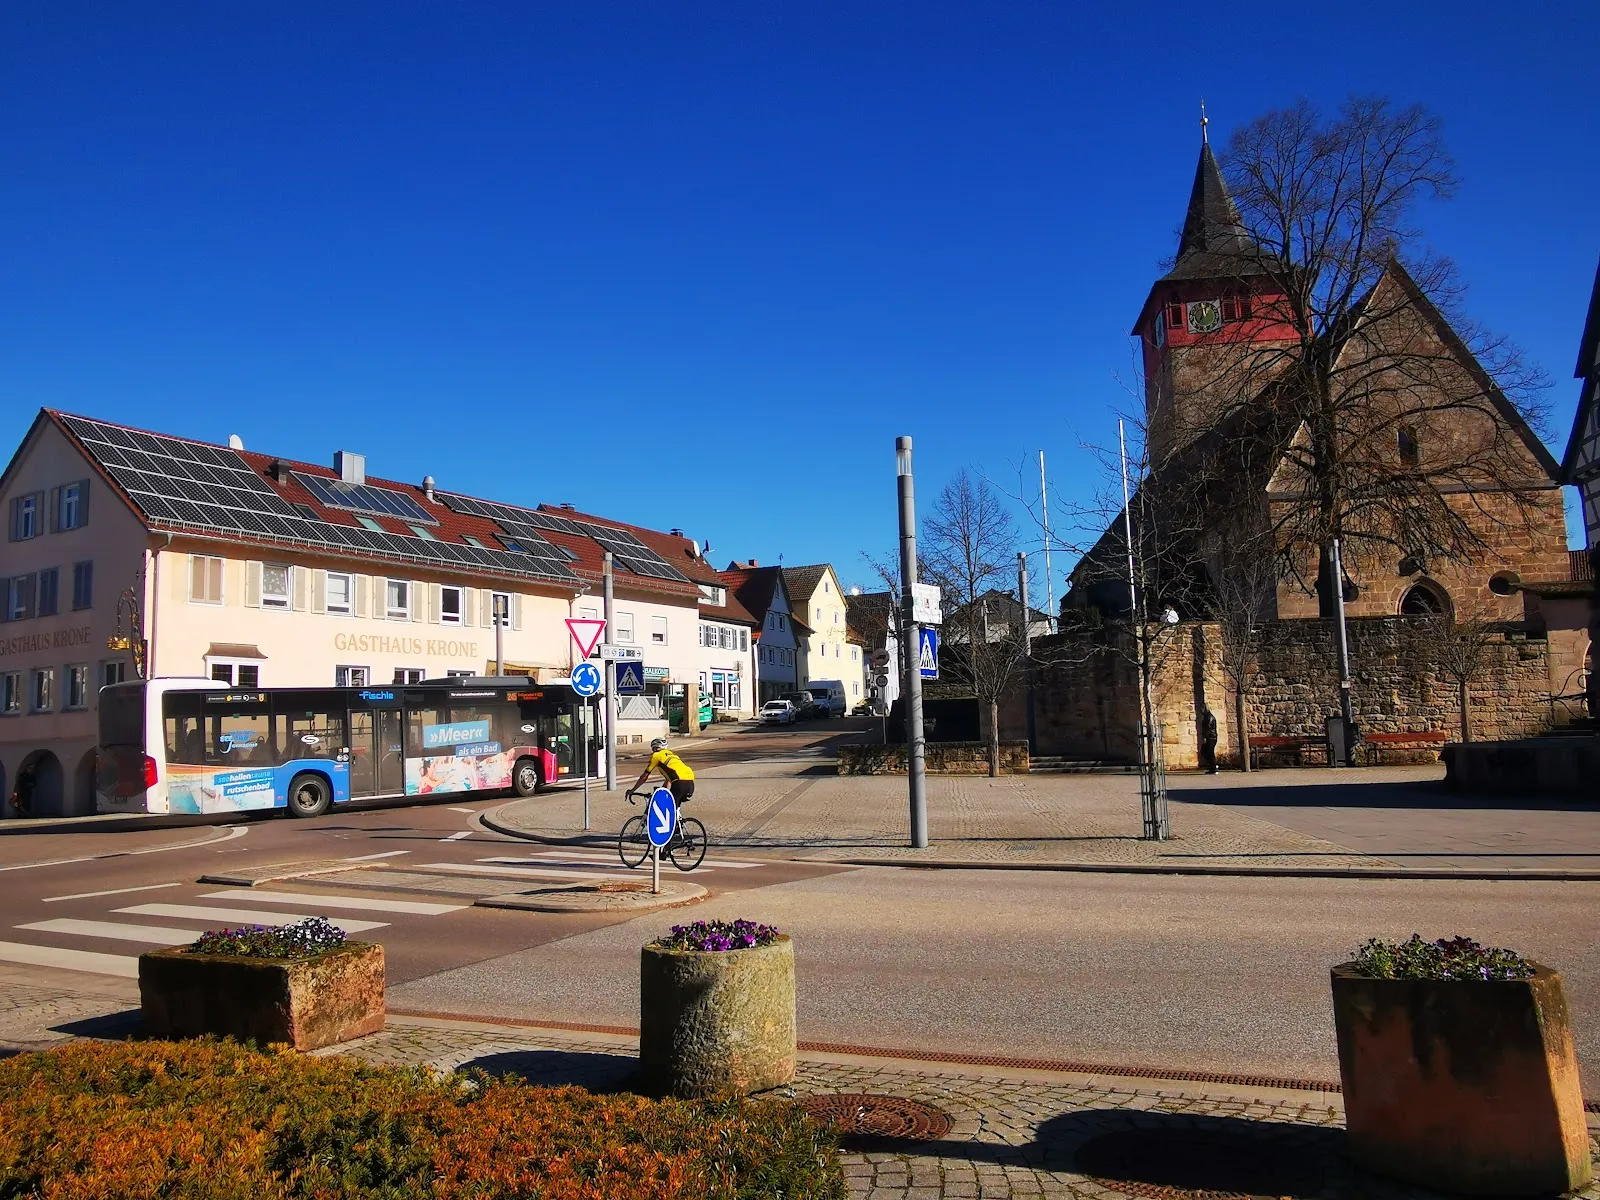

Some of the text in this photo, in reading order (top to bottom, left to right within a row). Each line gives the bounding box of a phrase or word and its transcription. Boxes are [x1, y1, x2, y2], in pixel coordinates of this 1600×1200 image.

[53, 626, 91, 649] KRONE
[334, 632, 478, 658] GASTHAUS KRONE
[359, 690, 394, 700] Fischle
[458, 742, 498, 756] als ein Bad
[227, 781, 270, 794] rutschenbad
